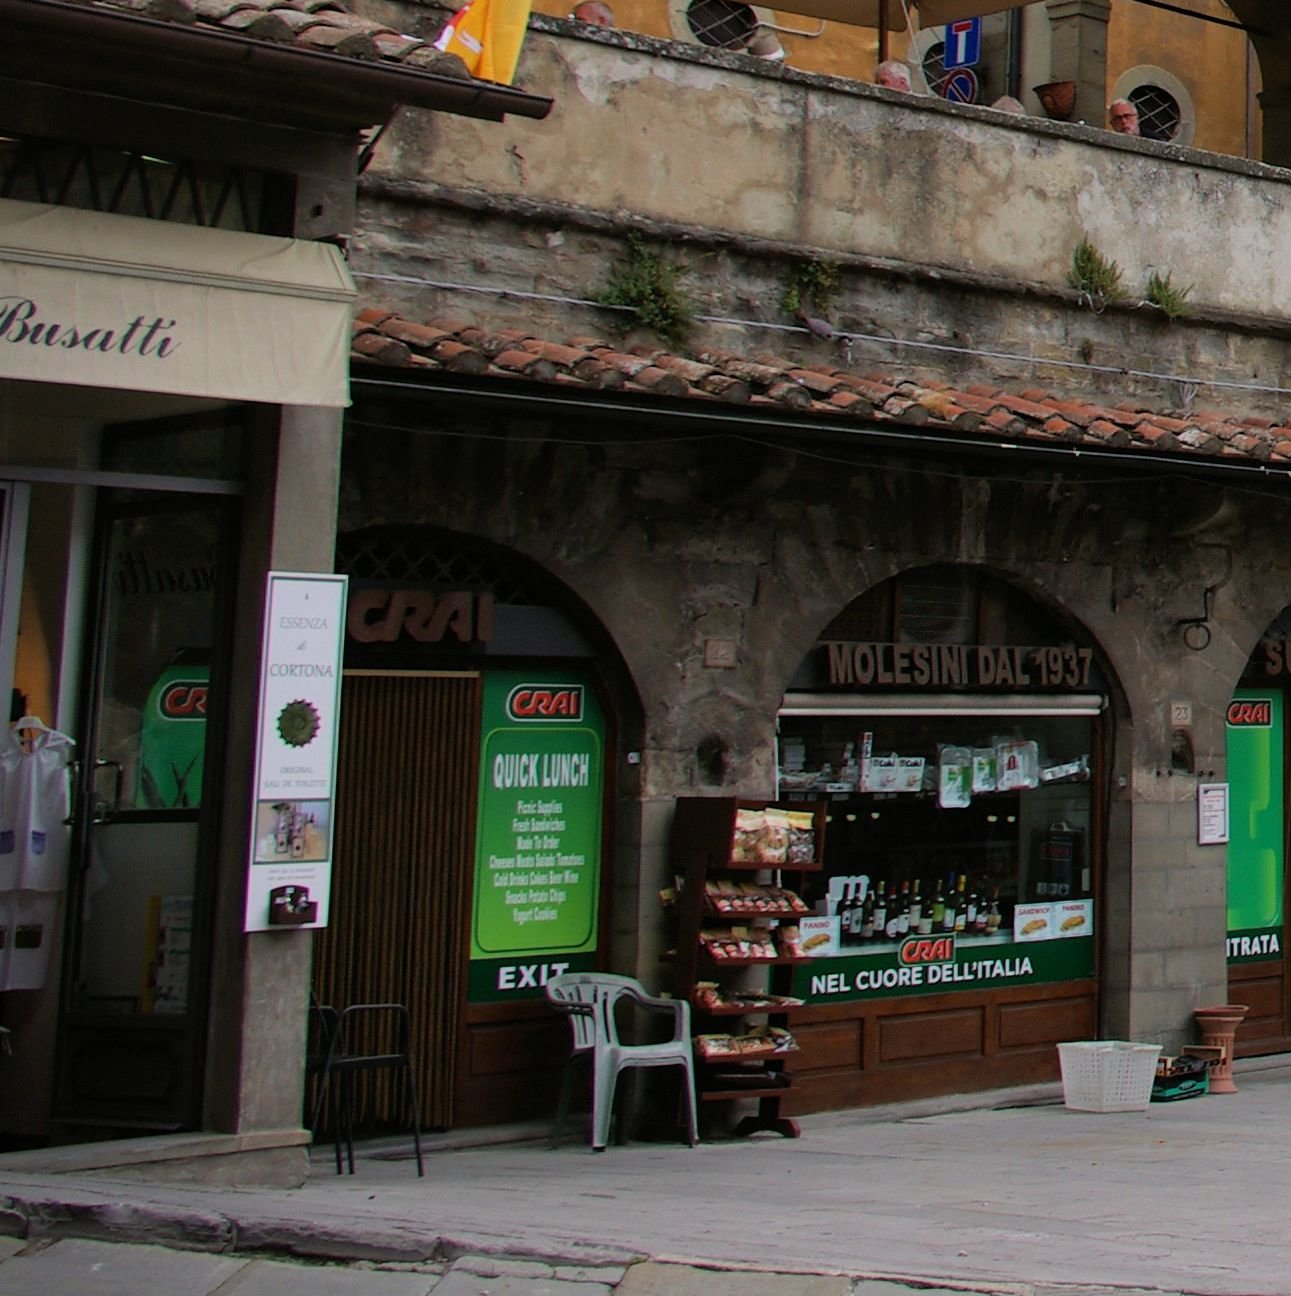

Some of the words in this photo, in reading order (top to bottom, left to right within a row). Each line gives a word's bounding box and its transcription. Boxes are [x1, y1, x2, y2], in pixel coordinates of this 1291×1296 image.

[0, 296, 182, 359] Busatti
[348, 588, 495, 642] CRAI
[270, 663, 334, 678] CORTONA
[827, 643, 970, 686] MOLESINI
[978, 644, 1031, 687] DAL
[1028, 646, 1093, 688] 1937
[512, 690, 580, 716] CRAI
[1174, 707, 1189, 721] 23
[1227, 703, 1269, 724] CRAI
[493, 753, 539, 791] QUICK
[542, 752, 590, 788] LUNCH
[901, 937, 954, 964] CRAI
[811, 973, 850, 996] NEL
[855, 965, 923, 992] CUORE
